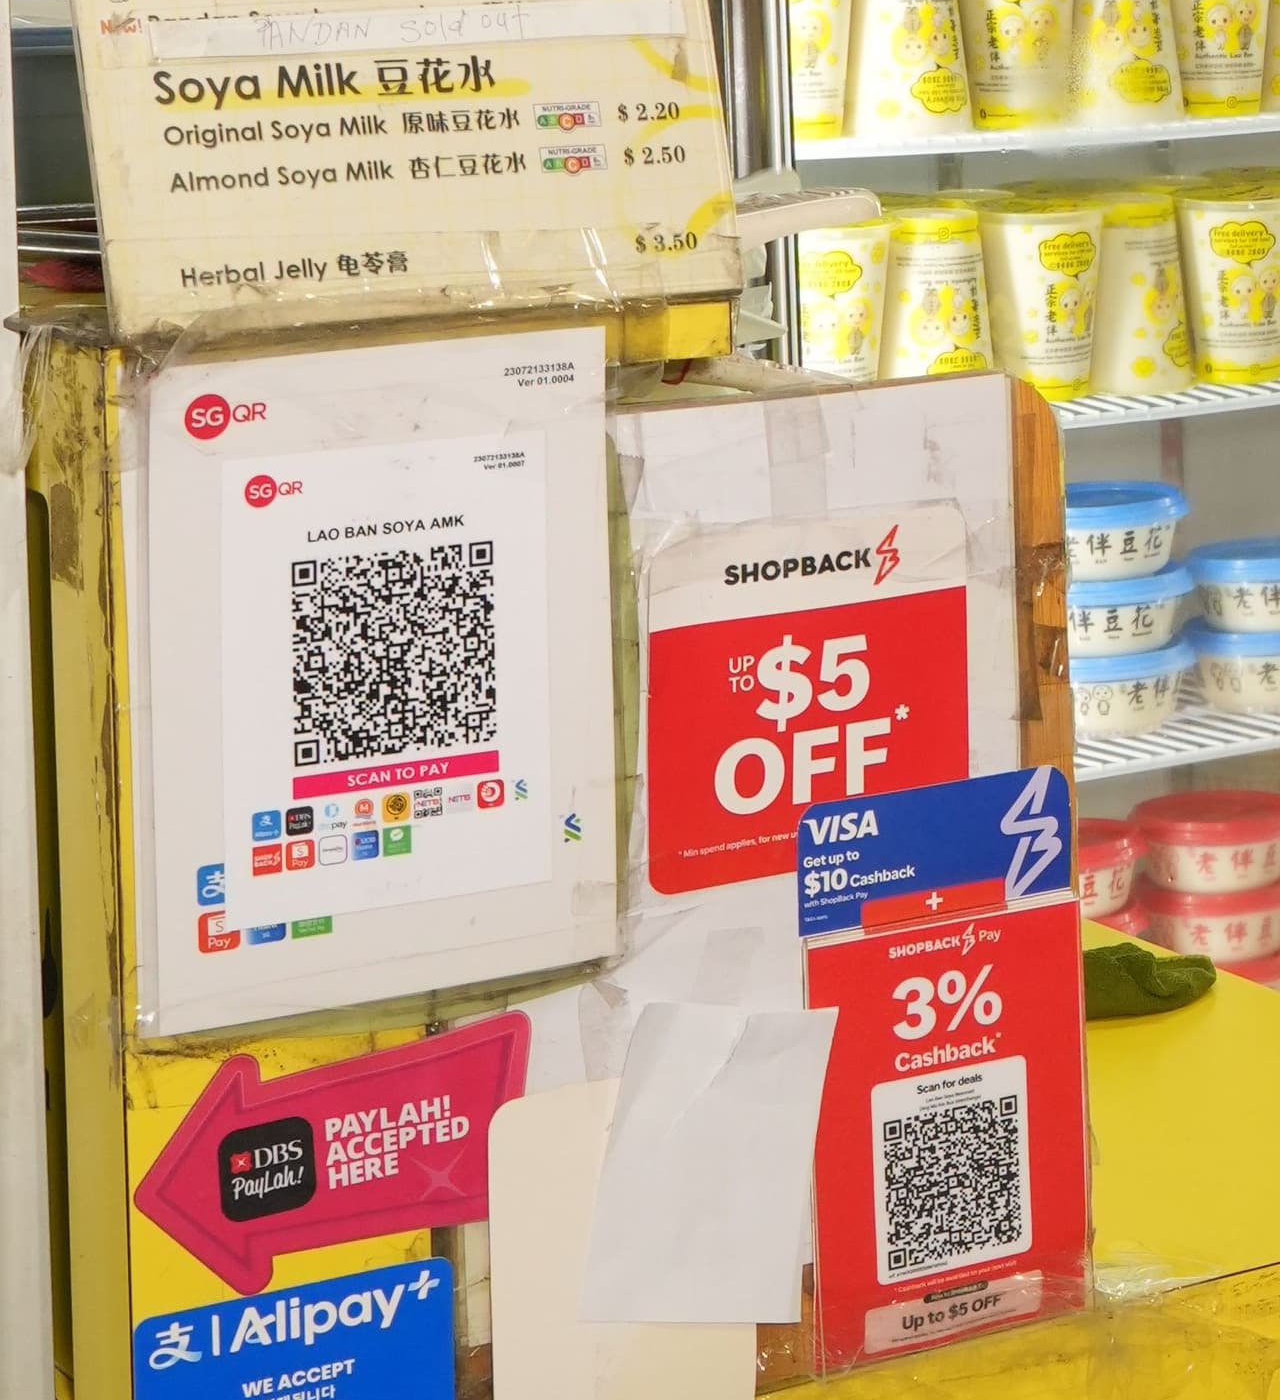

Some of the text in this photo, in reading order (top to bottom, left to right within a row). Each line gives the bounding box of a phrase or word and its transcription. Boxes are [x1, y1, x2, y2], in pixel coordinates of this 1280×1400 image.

[153, 56, 496, 109] Soya Milk 豆花水
[163, 122, 263, 148] Original
[270, 120, 333, 144] Soya
[339, 116, 387, 137] Milk
[402, 109, 520, 135] 原味豆花水
[636, 102, 680, 121] 2.20
[170, 171, 269, 195] Almond
[277, 166, 336, 190] Soya
[344, 161, 394, 182] Milk
[408, 154, 526, 181] 杏仁豆花水
[642, 146, 685, 165] 2.50
[652, 232, 697, 253] 3.50
[181, 252, 409, 287] Herbal Jelly 龟苓膏
[504, 362, 575, 377] 23072133138A
[517, 374, 575, 388] Ver 01.0004
[307, 514, 465, 543] LAO BAN SOYA AMK
[724, 548, 871, 586] SHOPBACK
[728, 655, 755, 674] UP
[729, 676, 754, 693] TO
[755, 634, 870, 732] $5
[347, 761, 449, 787] SCAN TO PAY
[700, 842, 725, 856] spend
[758, 834, 771, 844] for
[772, 833, 790, 842] new
[803, 810, 879, 845] VISA
[803, 850, 860, 868] Get up to
[804, 864, 916, 898] $10 Cashback
[208, 937, 231, 949] Pay
[888, 926, 1002, 959] SHOPBACK Pay
[892, 963, 1003, 1041] 3%
[917, 1085, 940, 1095] Scan
[942, 1080, 956, 1089] for
[958, 1074, 983, 1087] deals
[324, 1095, 451, 1142] PAYLAH!
[254, 1140, 303, 1169] DBS
[326, 1116, 469, 1166] ACCEPTED
[231, 1166, 304, 1200] PayLah!
[329, 1153, 399, 1189] HERE
[902, 1315, 924, 1331] Up
[928, 1310, 945, 1322] to
[949, 1302, 968, 1321] $5
[971, 1294, 1002, 1312] OFF
[242, 1359, 355, 1399] WE ACCEPT
